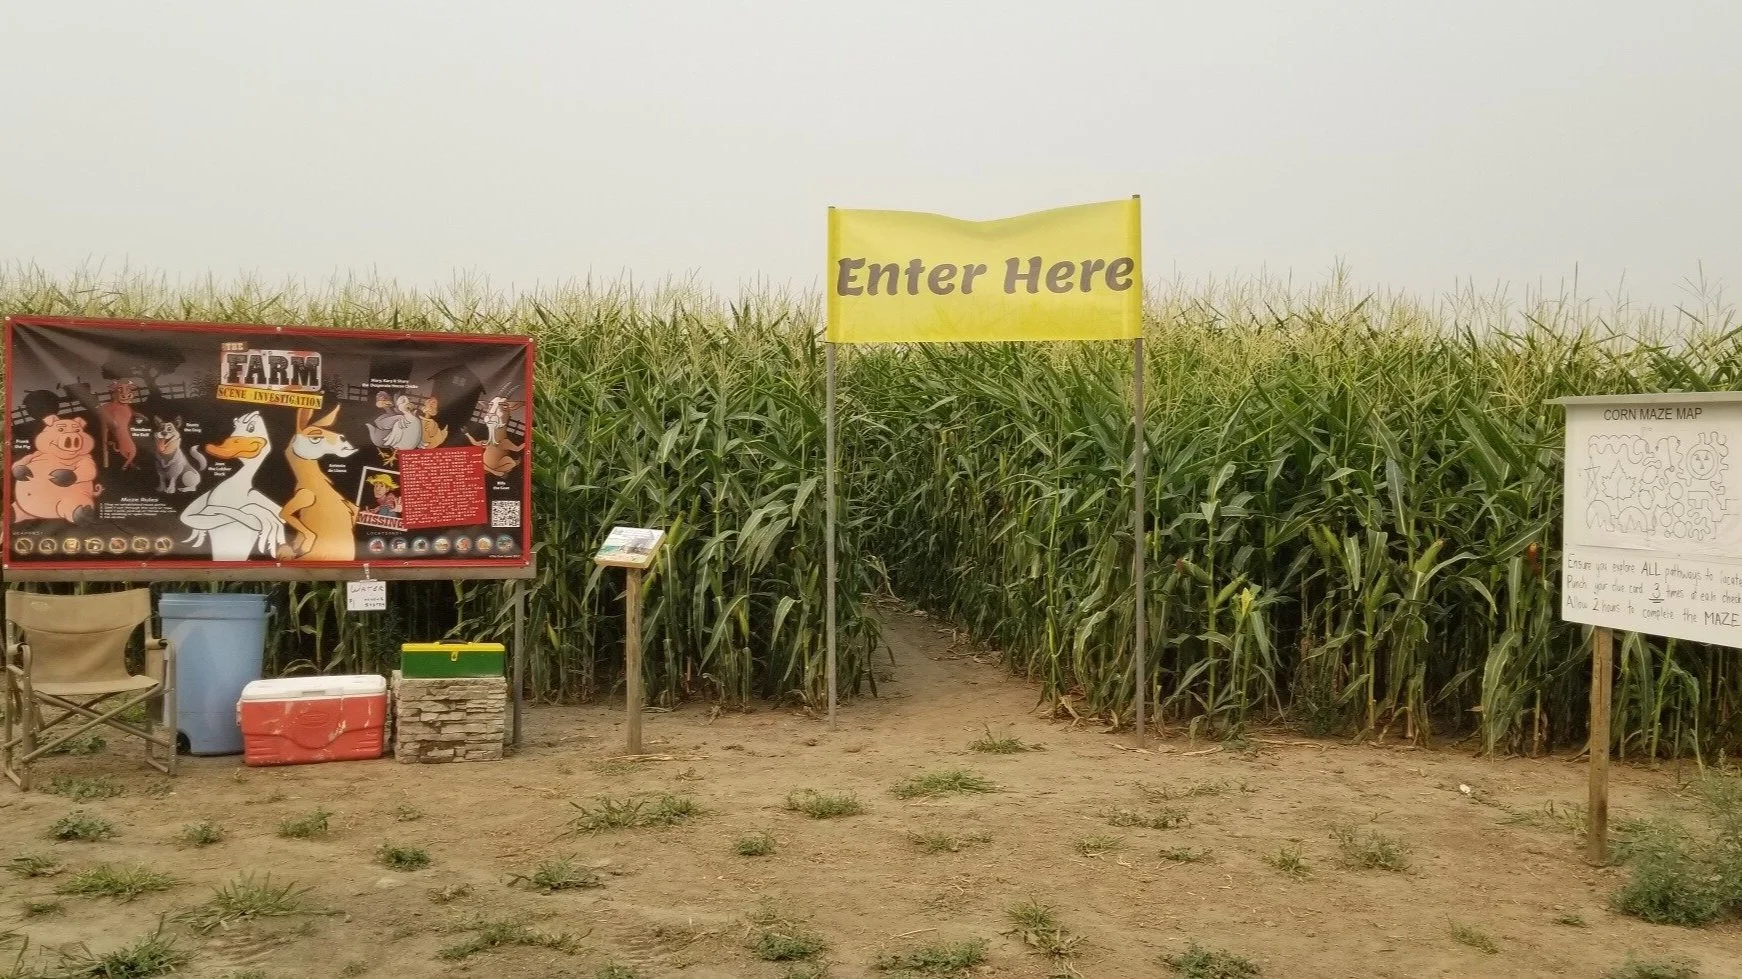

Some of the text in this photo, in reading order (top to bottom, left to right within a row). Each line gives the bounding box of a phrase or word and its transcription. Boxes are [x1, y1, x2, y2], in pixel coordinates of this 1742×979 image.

[836, 255, 1135, 297] Enter Here
[224, 342, 244, 351] THE
[226, 353, 321, 387] FARM
[218, 387, 323, 408] SCENE INVESTIGATION
[1603, 407, 1703, 421] CORN MAZE MAP
[358, 512, 403, 529] MISSING
[1567, 553, 1592, 571] Ensure
[1595, 560, 1608, 577] you
[1612, 560, 1636, 576] explore
[1641, 561, 1662, 577] ALL
[1664, 567, 1703, 587] pathways
[1705, 568, 1714, 582] to
[1566, 575, 1588, 590] Punch
[1594, 580, 1608, 595] your
[1628, 582, 1644, 594] card
[1651, 582, 1662, 600] 3
[1666, 585, 1685, 599] times
[1566, 595, 1742, 628] Allow 2 hours to complete the MAZE
